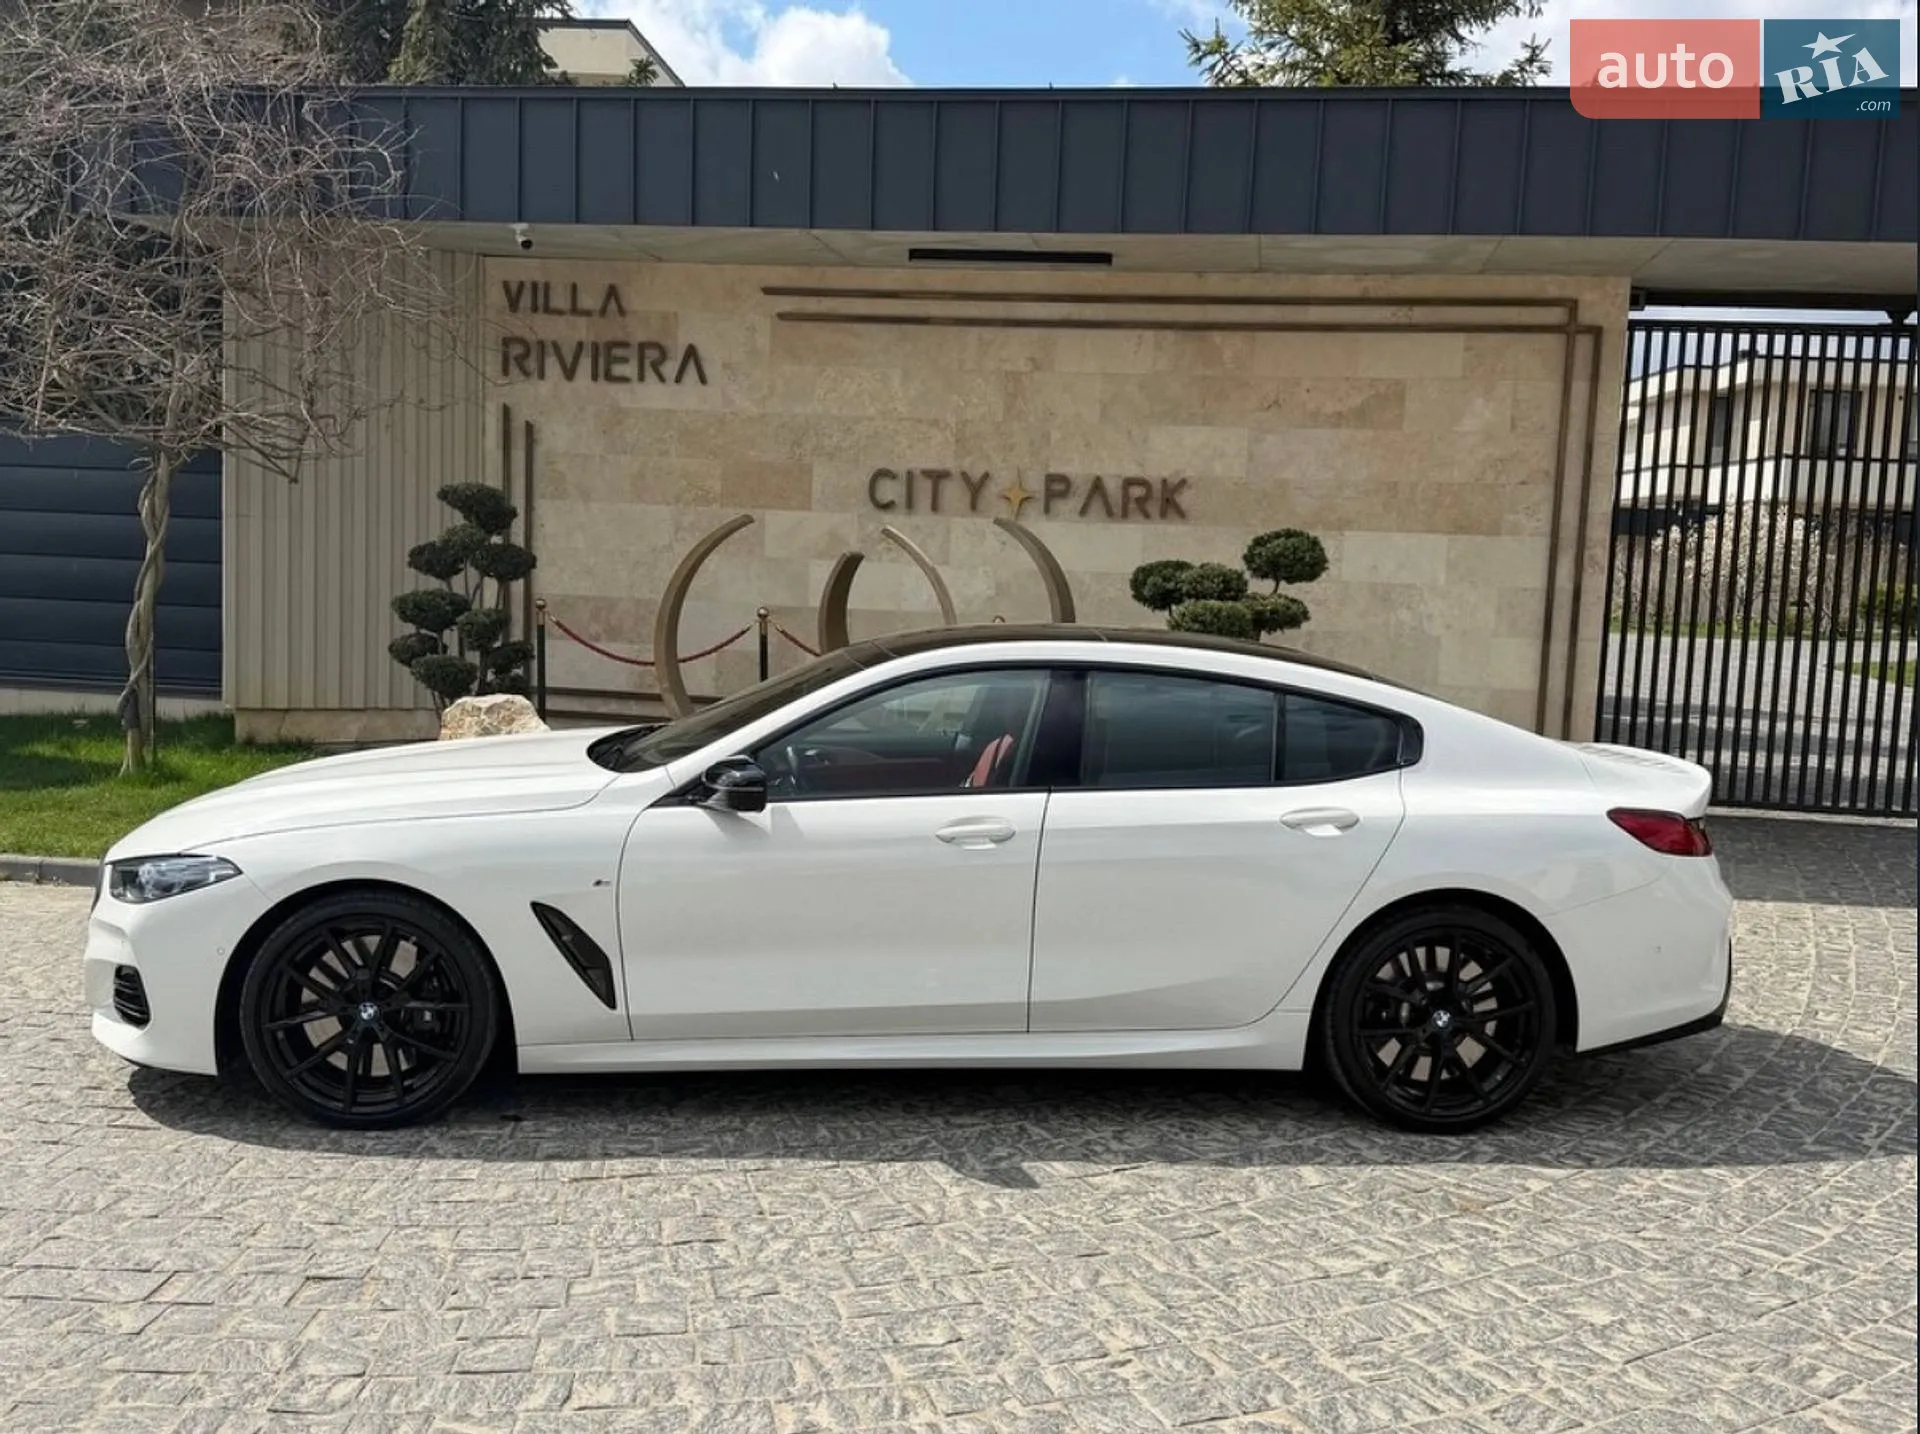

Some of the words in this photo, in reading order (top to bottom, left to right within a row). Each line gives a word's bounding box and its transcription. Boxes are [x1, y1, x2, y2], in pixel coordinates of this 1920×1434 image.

[502, 280, 626, 318] VILLA
[501, 336, 708, 385] RIVIERA
[868, 467, 990, 512] CITY
[1043, 473, 1188, 519] PARK
